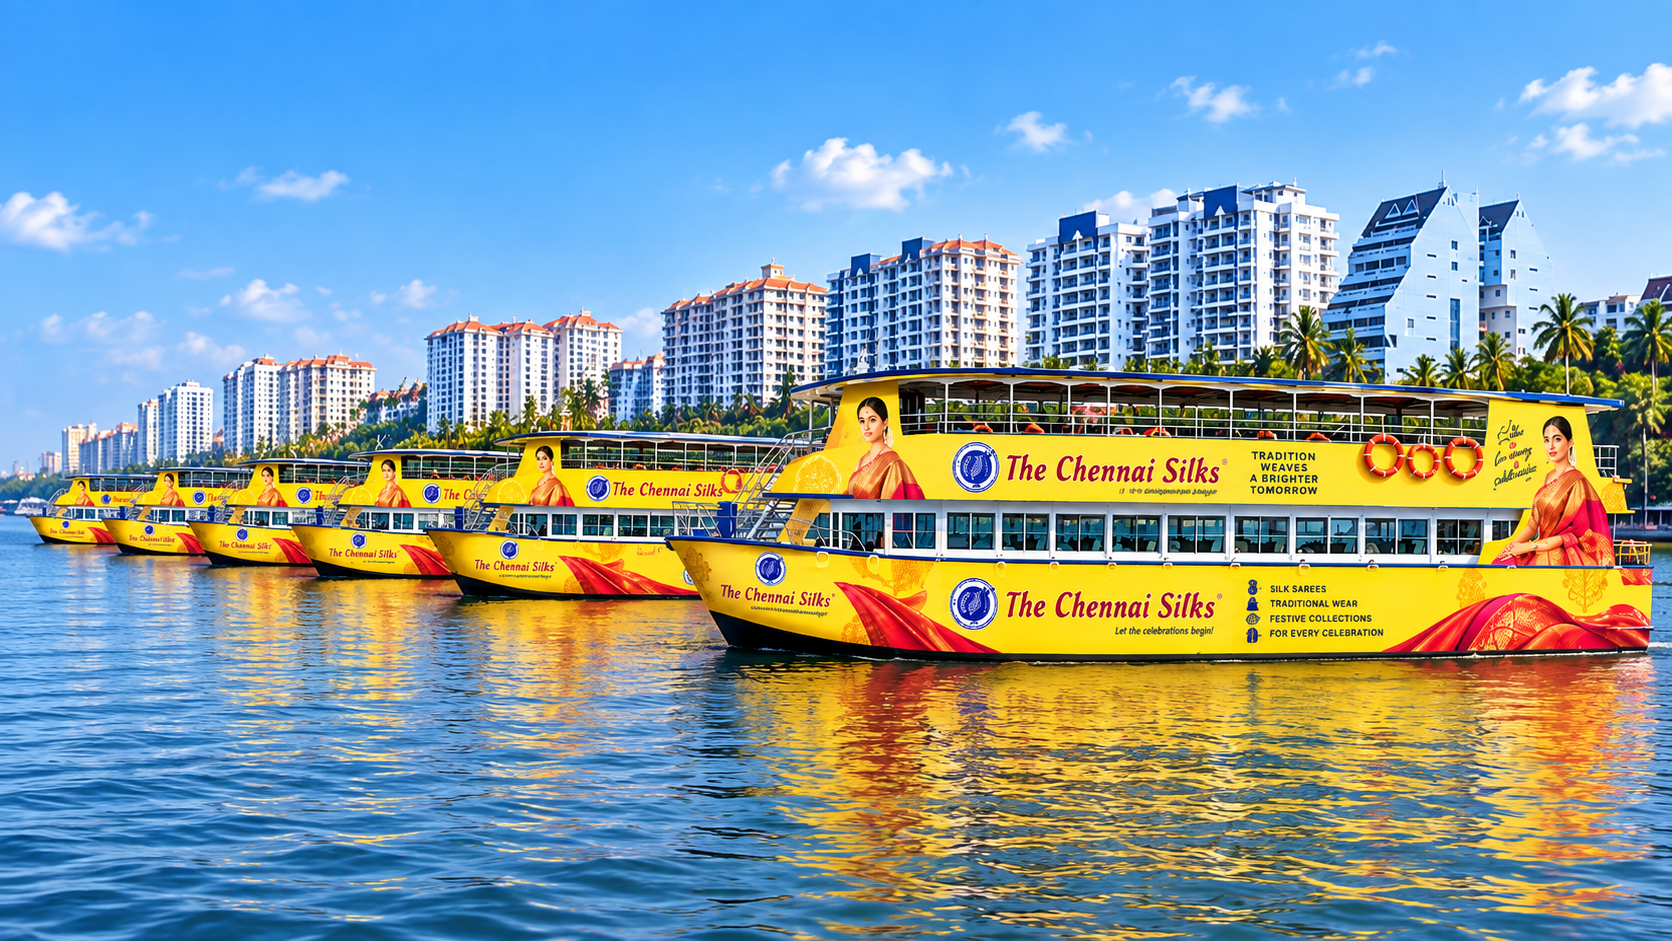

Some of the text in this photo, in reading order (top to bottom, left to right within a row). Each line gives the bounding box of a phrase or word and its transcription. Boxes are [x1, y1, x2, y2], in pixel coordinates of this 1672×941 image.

[1250, 450, 1316, 461] TRADITION
[1007, 454, 1219, 483] The Chennai Silks
[1260, 462, 1308, 473] WEAVES
[1249, 473, 1319, 484] A BRIGHTER
[443, 488, 461, 501] The
[613, 482, 723, 497] The Chennai Silks
[1250, 485, 1318, 495] TOMORROW
[328, 547, 343, 558] The
[474, 559, 491, 571] The
[493, 559, 531, 572] Chennai
[721, 585, 741, 599] The
[745, 587, 795, 604] Chennai
[1270, 584, 1327, 594] SILK SAREES
[1007, 591, 1215, 618] The Chennai Silks
[1269, 599, 1358, 608] TRADITIONAL WEAR
[1269, 614, 1373, 624] FESTIVE COLLECTIONS
[1114, 625, 1215, 638] Let the celebrations begin!
[1269, 628, 1384, 638] FOR EVERY CELEBRATION
